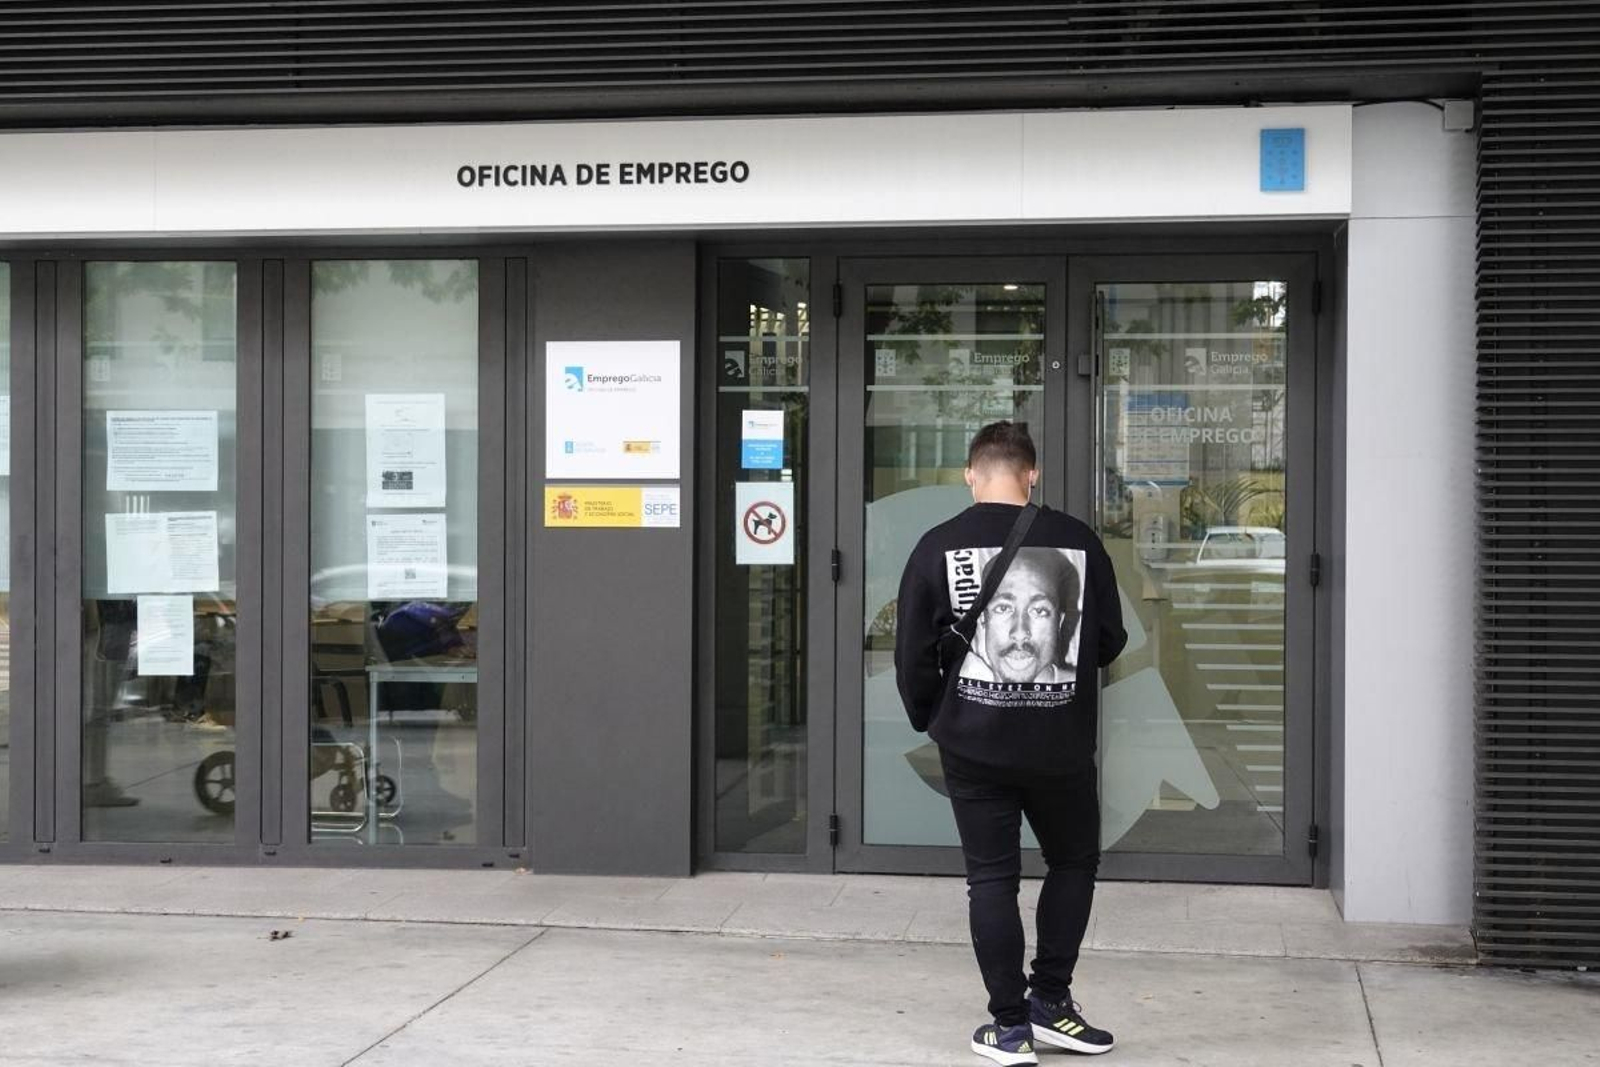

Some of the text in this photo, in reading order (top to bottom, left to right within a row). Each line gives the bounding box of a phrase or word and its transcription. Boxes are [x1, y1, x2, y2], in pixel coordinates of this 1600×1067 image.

[456, 161, 750, 187] OFICINA DE EMPREGO
[973, 352, 1030, 365] Emprego
[1210, 351, 1269, 365] Emprego
[1150, 406, 1234, 423] OFICINA
[1159, 427, 1265, 444] EMPREGO
[644, 503, 678, 516] SEPE
[957, 678, 1077, 692] ALL EYEZ ON ME
